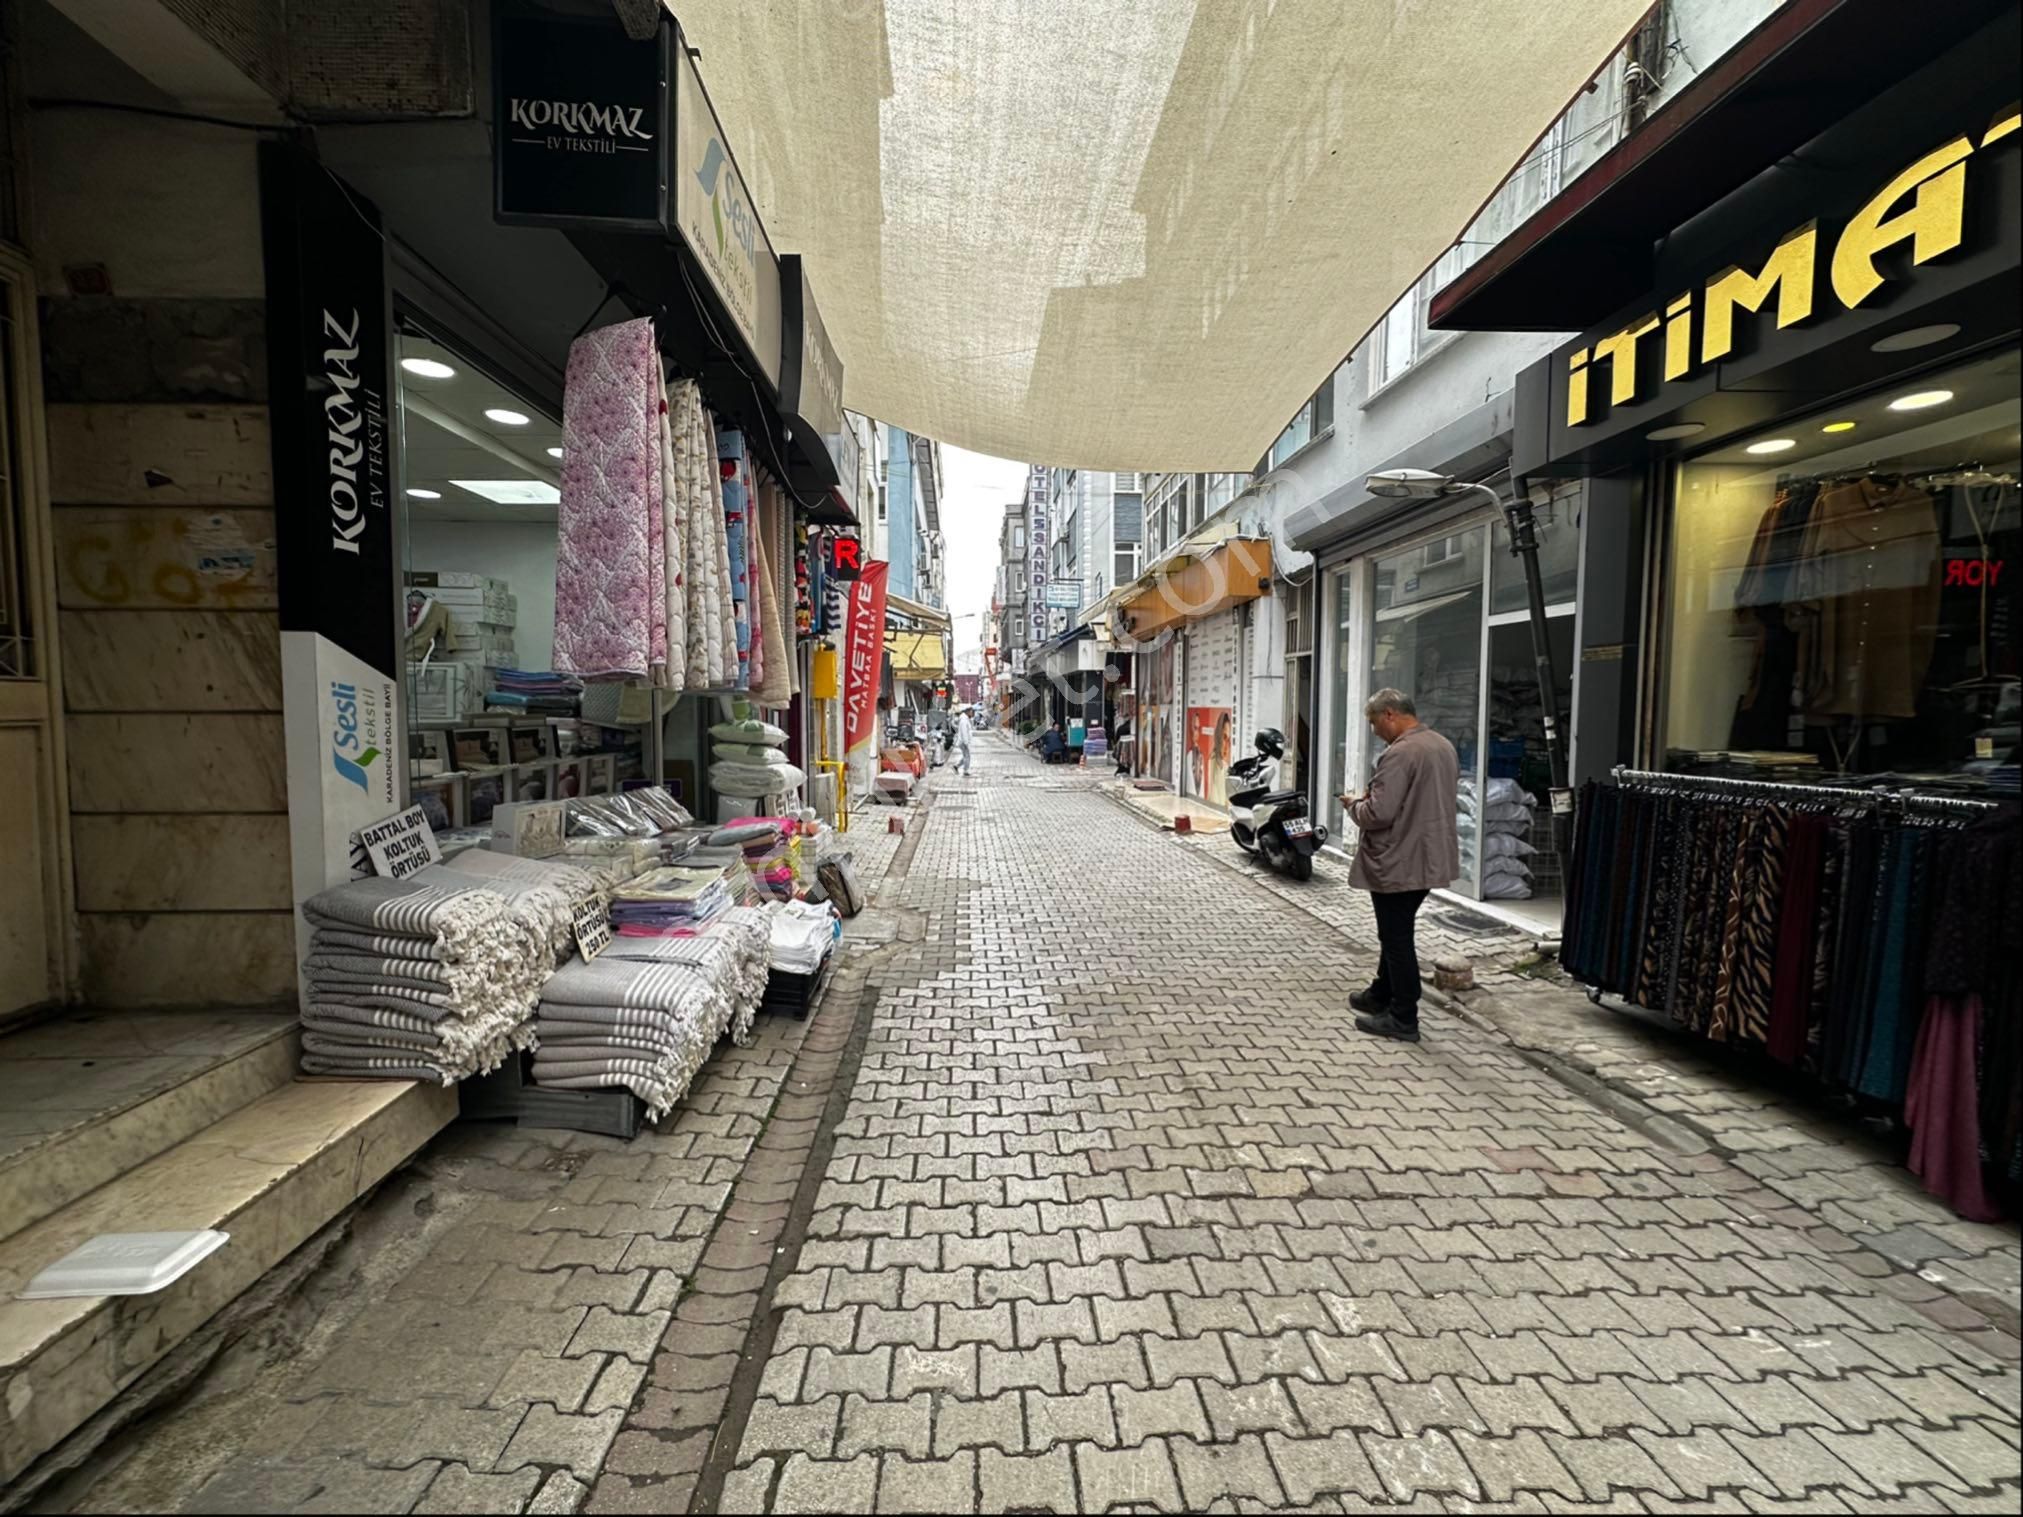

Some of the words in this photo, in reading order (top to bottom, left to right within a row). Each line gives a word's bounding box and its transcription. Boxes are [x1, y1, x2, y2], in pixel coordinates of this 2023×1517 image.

[511, 98, 653, 140] KORKMAZ
[547, 136, 562, 149] EV
[566, 136, 616, 154] TEKSTİLİ
[722, 170, 755, 270] Sesli
[723, 235, 753, 306] tekstil
[1567, 113, 2022, 428] İTİMA
[323, 307, 366, 556] KORKMAZ
[364, 388, 384, 477] TEKSTİLİ
[370, 484, 384, 509] EV
[835, 538, 860, 569] R
[847, 582, 873, 735] DAVETİYE
[860, 654, 874, 710] MATBAA
[331, 681, 359, 751] Sesli
[362, 687, 377, 746] tekstil
[383, 712, 393, 745] BÖLGE
[384, 747, 393, 803] KARADENİZ
[364, 818, 407, 848] BATTAL
[405, 809, 426, 829] BOY
[383, 831, 425, 861] KOLTUK
[389, 846, 432, 879] ÖRTÜSÜ
[573, 895, 600, 923] KOLTUK
[599, 930, 610, 945] TL
